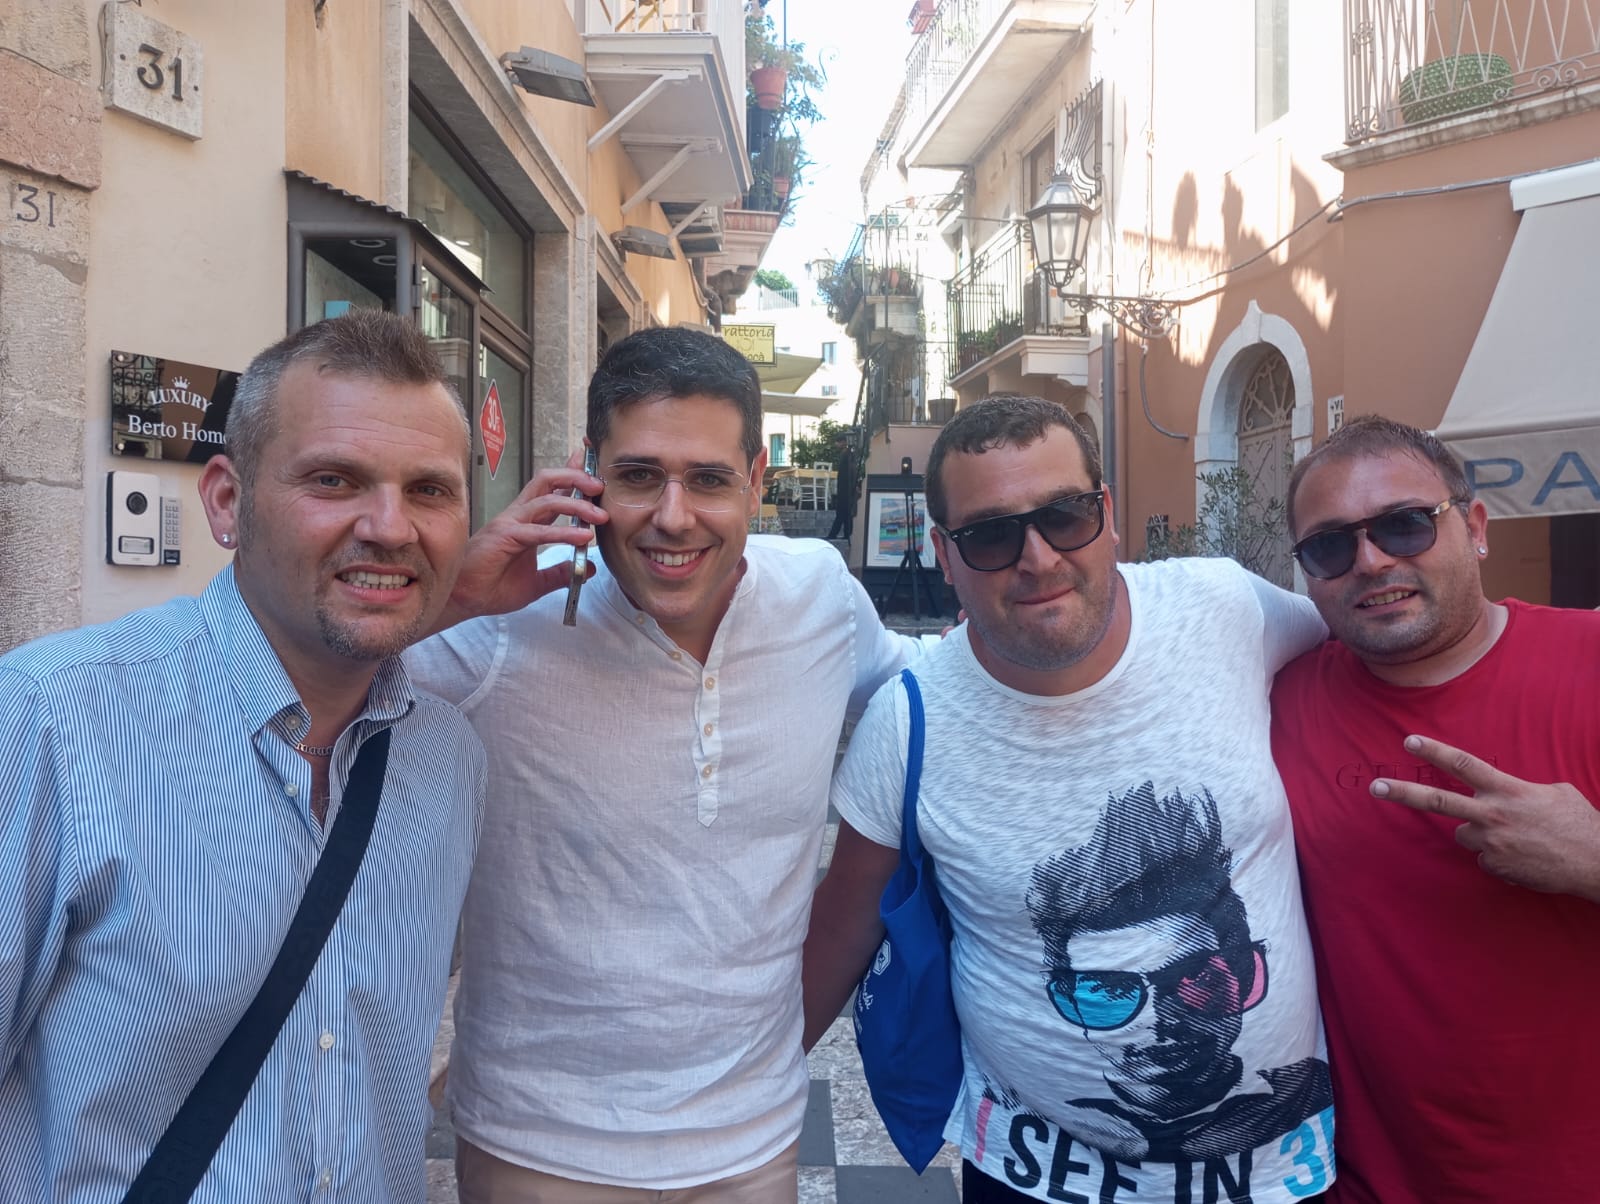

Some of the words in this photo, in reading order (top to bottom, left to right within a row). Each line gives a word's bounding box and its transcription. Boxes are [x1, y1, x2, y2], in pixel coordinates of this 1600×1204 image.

[137, 43, 184, 102] 31
[16, 183, 57, 228] 31
[721, 326, 773, 337] rattoria
[150, 388, 213, 413] LUXURY
[128, 414, 177, 438] Berto
[1464, 451, 1600, 506] PA
